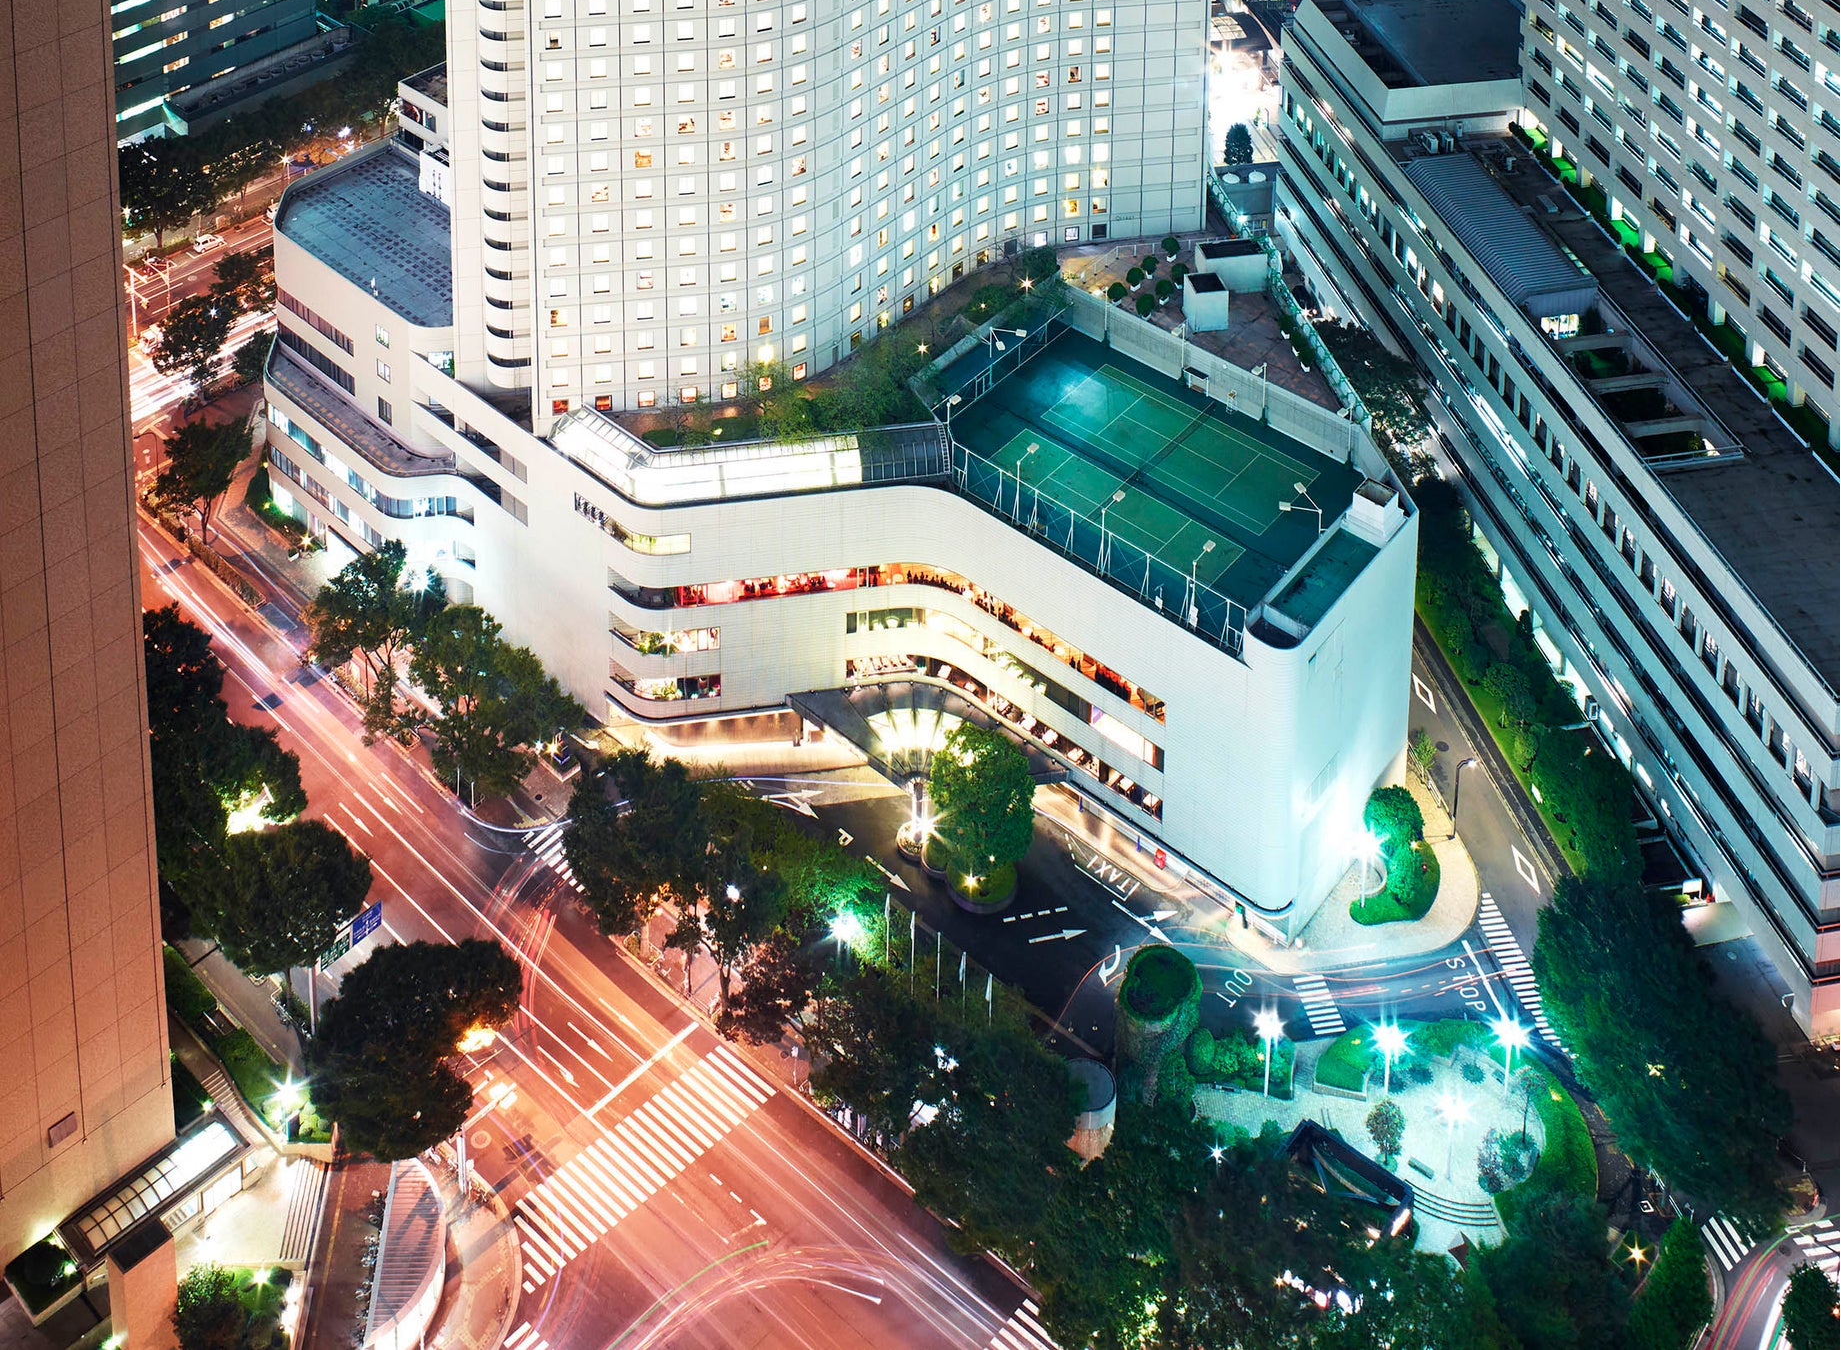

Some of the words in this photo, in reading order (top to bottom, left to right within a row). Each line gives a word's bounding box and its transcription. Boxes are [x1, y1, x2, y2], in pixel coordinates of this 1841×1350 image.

[838, 827, 854, 847] P
[1086, 854, 1131, 893] TAXI
[1216, 969, 1253, 1008] OUT
[1446, 957, 1487, 1011] STOP
